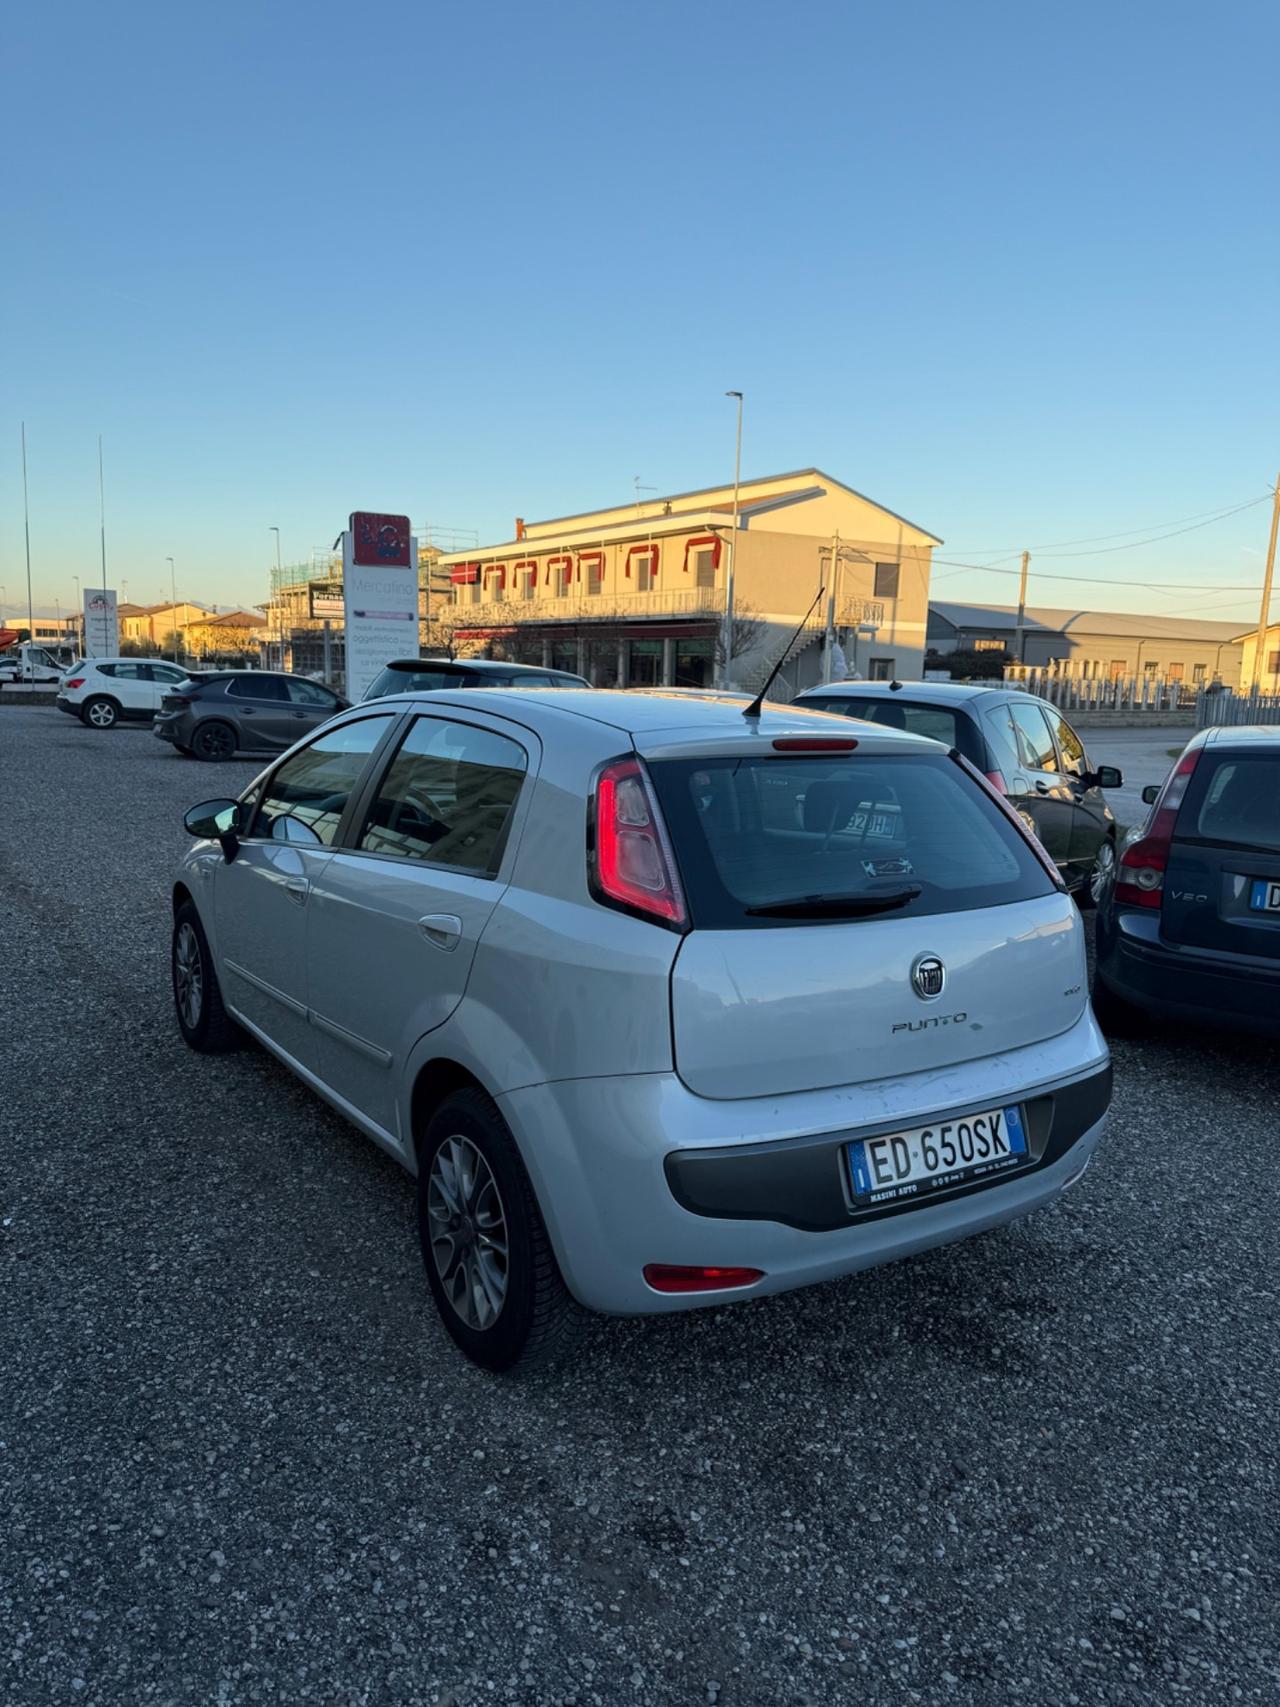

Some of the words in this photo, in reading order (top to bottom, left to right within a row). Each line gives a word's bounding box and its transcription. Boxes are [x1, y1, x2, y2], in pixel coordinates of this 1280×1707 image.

[352, 579, 414, 596] Mercatino
[892, 1012, 968, 1034] PUNTO
[870, 1189, 897, 1203] MASINI
[898, 1184, 918, 1196] AUTO
